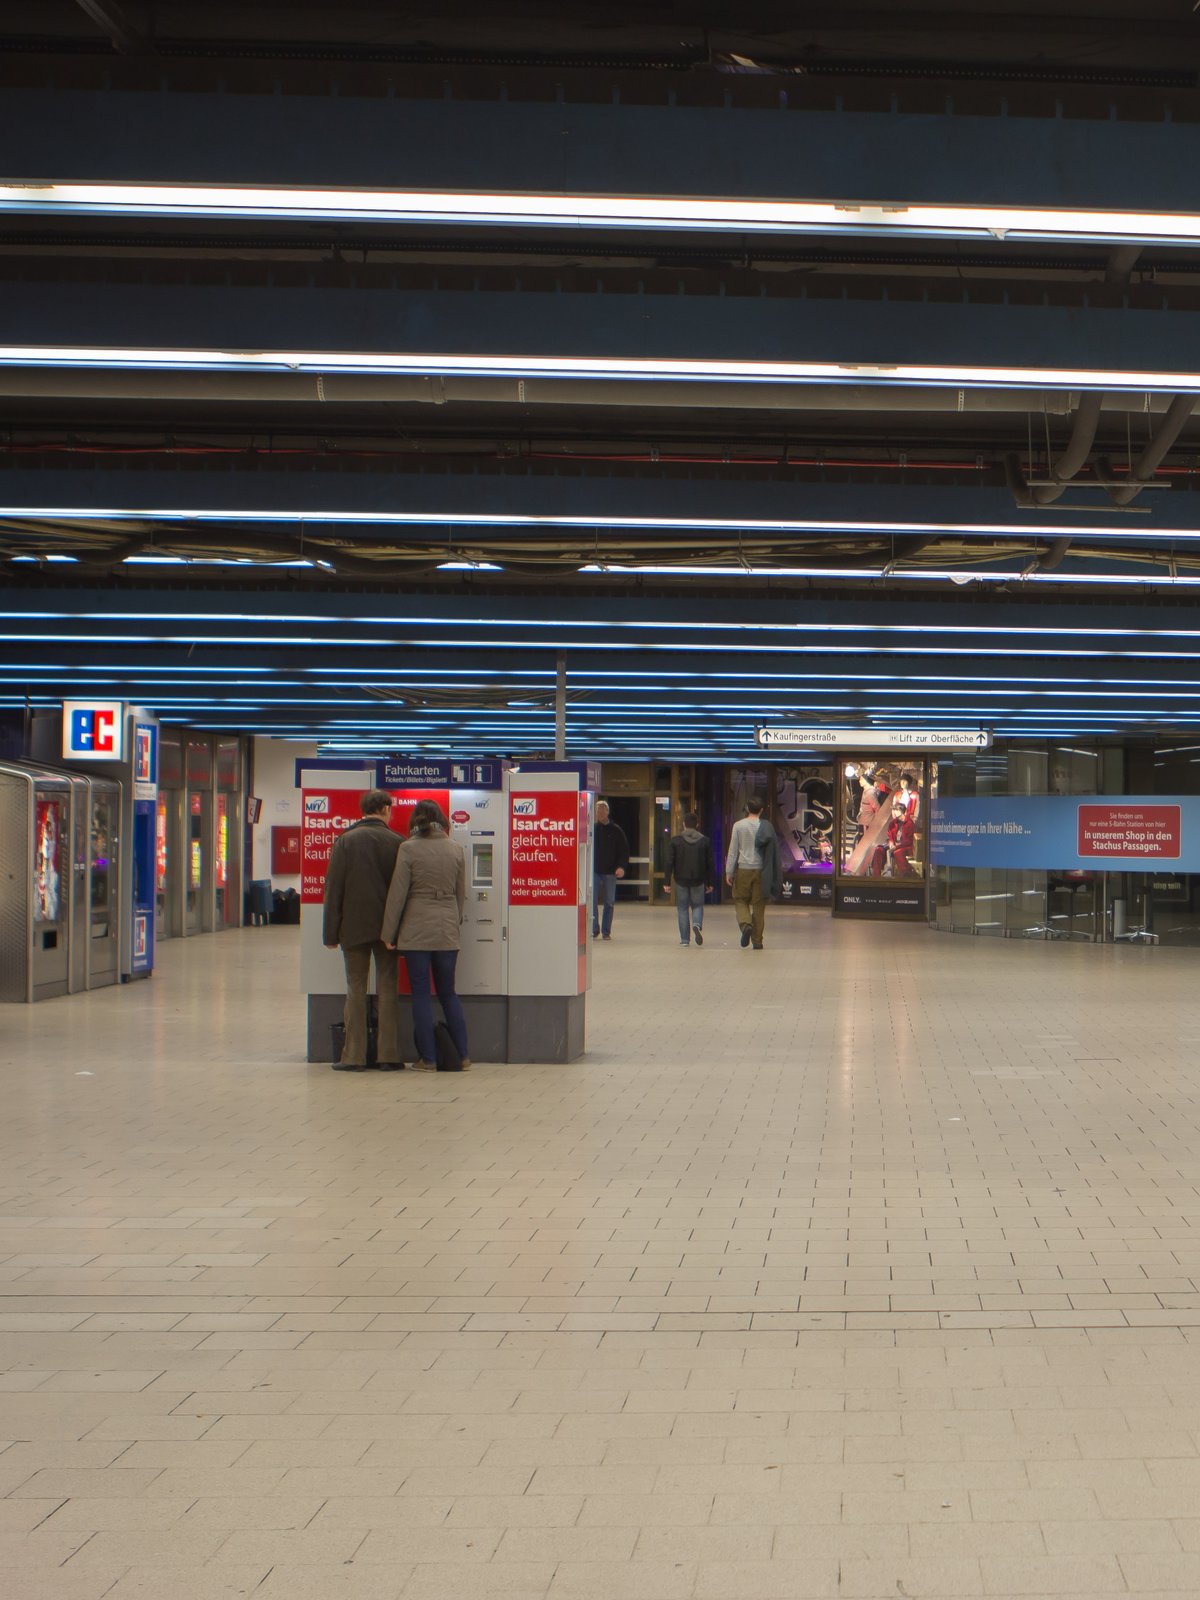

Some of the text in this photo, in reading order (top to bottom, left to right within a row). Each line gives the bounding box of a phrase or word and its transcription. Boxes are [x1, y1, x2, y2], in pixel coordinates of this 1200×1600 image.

[773, 732, 836, 743] Kaufingerstraße
[900, 734, 912, 743] Lift
[931, 734, 973, 743] Oberfläche
[385, 765, 440, 775] Fahrkarten
[304, 816, 366, 828] IsarCar
[512, 818, 574, 831] IsarCard
[980, 822, 986, 833] in
[987, 822, 1002, 834] Ihrer
[1003, 822, 1022, 834] Nähe
[512, 834, 574, 849] gleich hier
[1084, 830, 1172, 842] in unserem Shop in den
[1092, 841, 1162, 853] Stachus Passagen.
[304, 848, 331, 859] kauf
[512, 849, 557, 862] kaufen.
[304, 876, 317, 884] Mit
[512, 878, 557, 887] Mit Bargeld
[512, 888, 567, 898] oder girocard.
